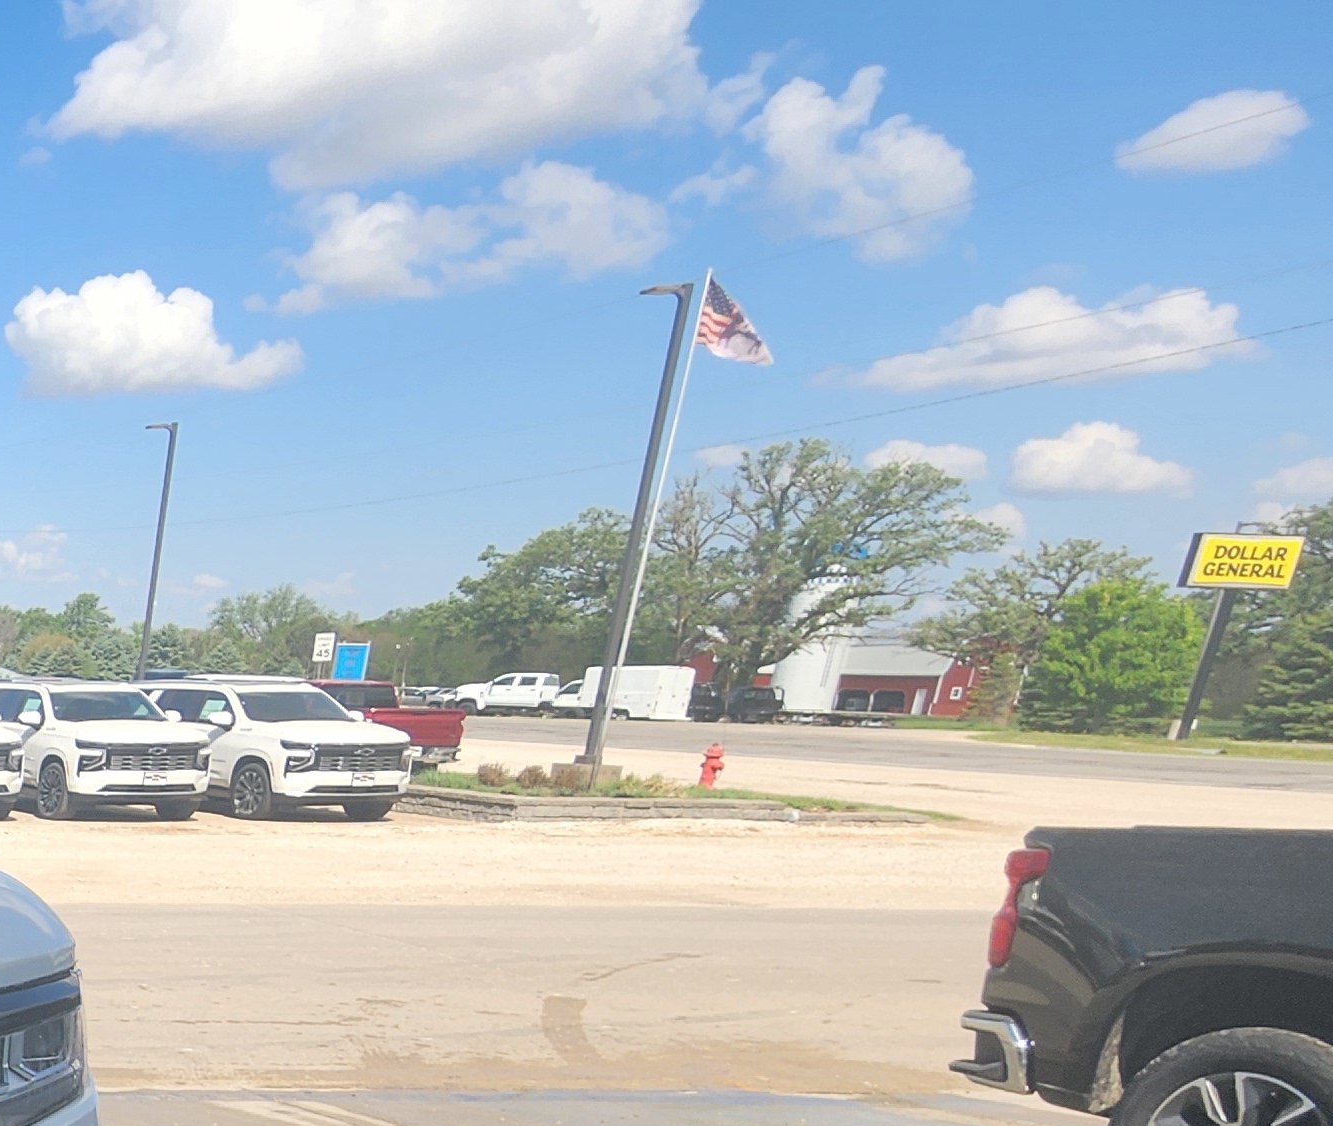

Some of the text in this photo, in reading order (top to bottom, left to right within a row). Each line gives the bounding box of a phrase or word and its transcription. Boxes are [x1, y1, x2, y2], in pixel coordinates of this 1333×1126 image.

[1214, 545, 1288, 561] DOLLAR
[1203, 562, 1285, 578] GENERAL
[316, 648, 331, 658] 45
